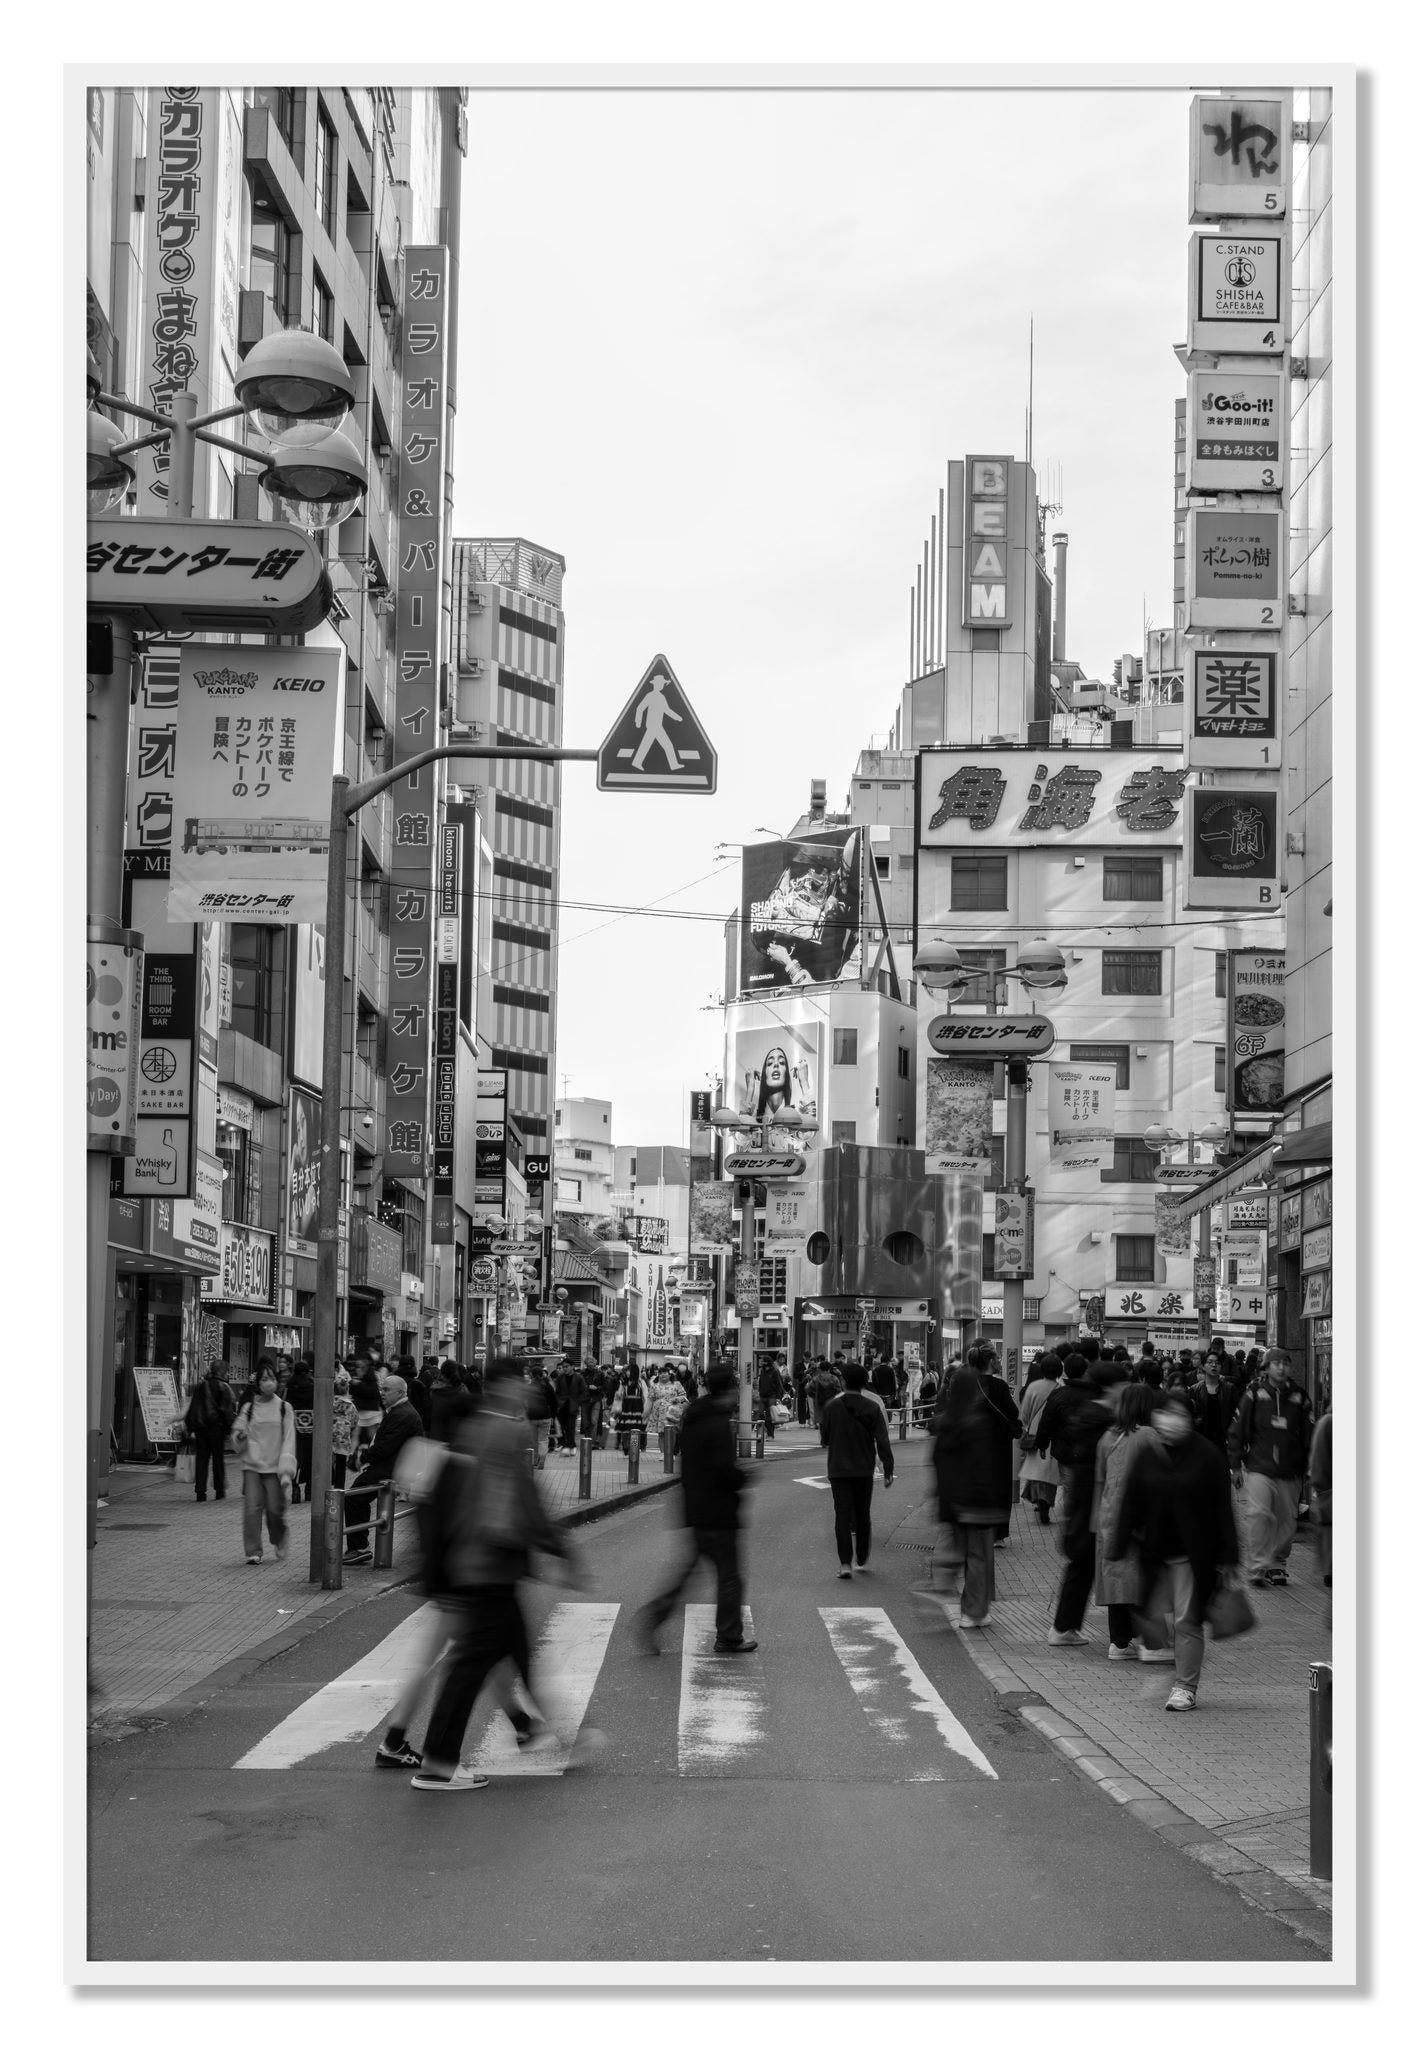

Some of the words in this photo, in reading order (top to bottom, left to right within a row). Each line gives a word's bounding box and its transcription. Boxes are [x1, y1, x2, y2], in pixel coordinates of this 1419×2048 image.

[157, 101, 203, 251] カラオケ
[1264, 193, 1278, 210] 5
[1216, 245, 1265, 255] C.STAND
[1216, 289, 1264, 300] SHISHA
[1216, 301, 1264, 310] CAFE&BAR
[1263, 331, 1276, 347] 4
[1214, 395, 1274, 412] Goo-it!
[1206, 416, 1270, 427] 渋谷宇田川町店
[1201, 444, 1275, 457] 全身もみほぐし
[1261, 469, 1275, 487] 3
[970, 461, 1008, 618] BEAM
[1202, 546, 1271, 567] ポムの樹
[1213, 571, 1263, 580] Pomme-no-ki
[1260, 607, 1274, 624] 2
[207, 686, 245, 695] KANTO
[273, 677, 325, 693] KEIO
[1205, 659, 1261, 715] 薬
[1200, 718, 1266, 734] マツモトキヨシ
[212, 716, 230, 763] 冒険へ
[231, 716, 252, 797] カントーの
[253, 716, 275, 798] ポケパーク
[277, 717, 297, 783] 京王線で
[1260, 746, 1270, 763] 1
[928, 763, 1188, 831] 角海老
[1200, 807, 1265, 860] 一蘭
[445, 873, 453, 911] hearts
[1259, 886, 1272, 903] B
[199, 893, 296, 908] 渋谷センター街
[750, 899, 793, 913] SHAPING
[149, 975, 174, 983] THIRD
[153, 967, 169, 976] THE
[749, 973, 775, 982] SALOMON
[1237, 972, 1286, 986] 四川料理
[149, 1006, 172, 1015] ROOM
[152, 1017, 168, 1026] BAR
[935, 1025, 1048, 1040] 渋谷センター街
[1235, 1035, 1266, 1056] 6F
[97, 1087, 119, 1103] Day!
[141, 1101, 163, 1109] SAKE
[166, 1101, 184, 1109] BAR
[489, 1130, 502, 1138] UP
[135, 1157, 172, 1169] Whisky
[527, 1161, 549, 1174] GU
[728, 1159, 796, 1168] 渋谷センター街
[135, 1168, 157, 1178] Bank
[1158, 1168, 1219, 1179] 渋谷センター街
[1120, 1291, 1185, 1315] 兆楽
[655, 1289, 665, 1336] BEER
